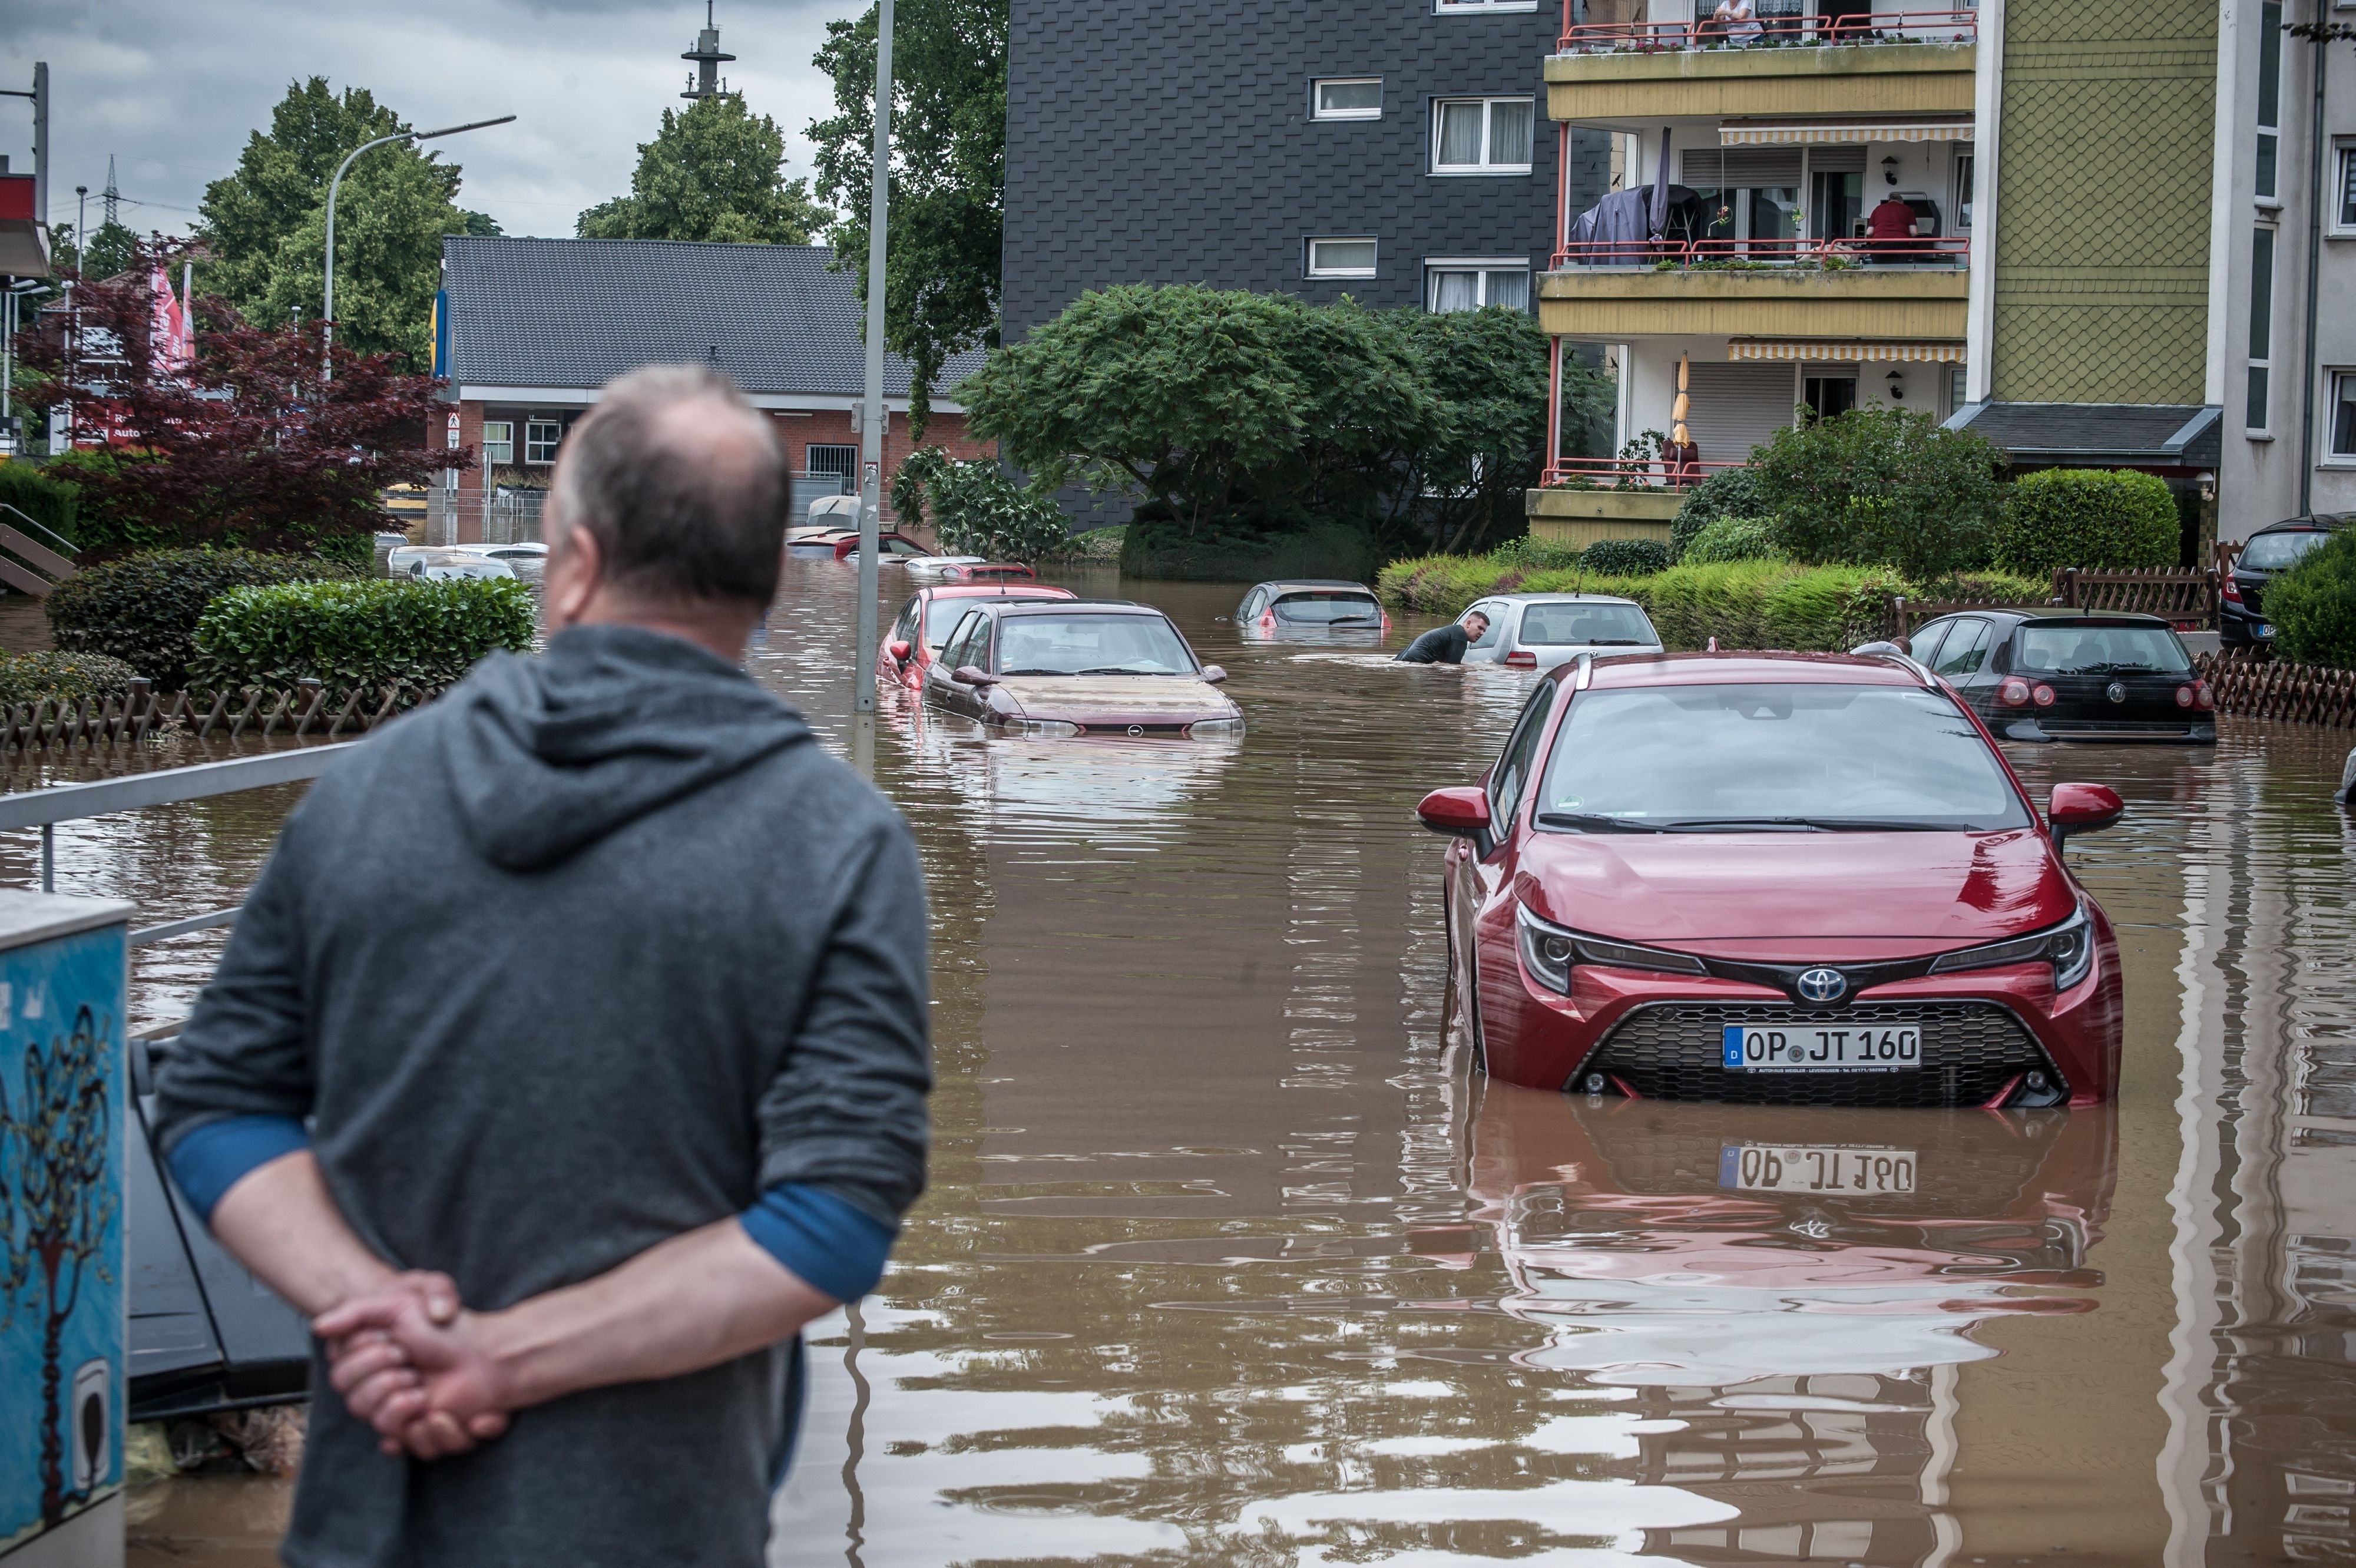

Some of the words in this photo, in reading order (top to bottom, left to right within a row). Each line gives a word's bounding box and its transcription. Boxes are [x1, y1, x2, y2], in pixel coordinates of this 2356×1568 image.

[1730, 1050, 1738, 1059] D
[1746, 1032, 1786, 1061] OP
[1809, 1031, 1849, 1061] JT
[1858, 1031, 1916, 1060] 160
